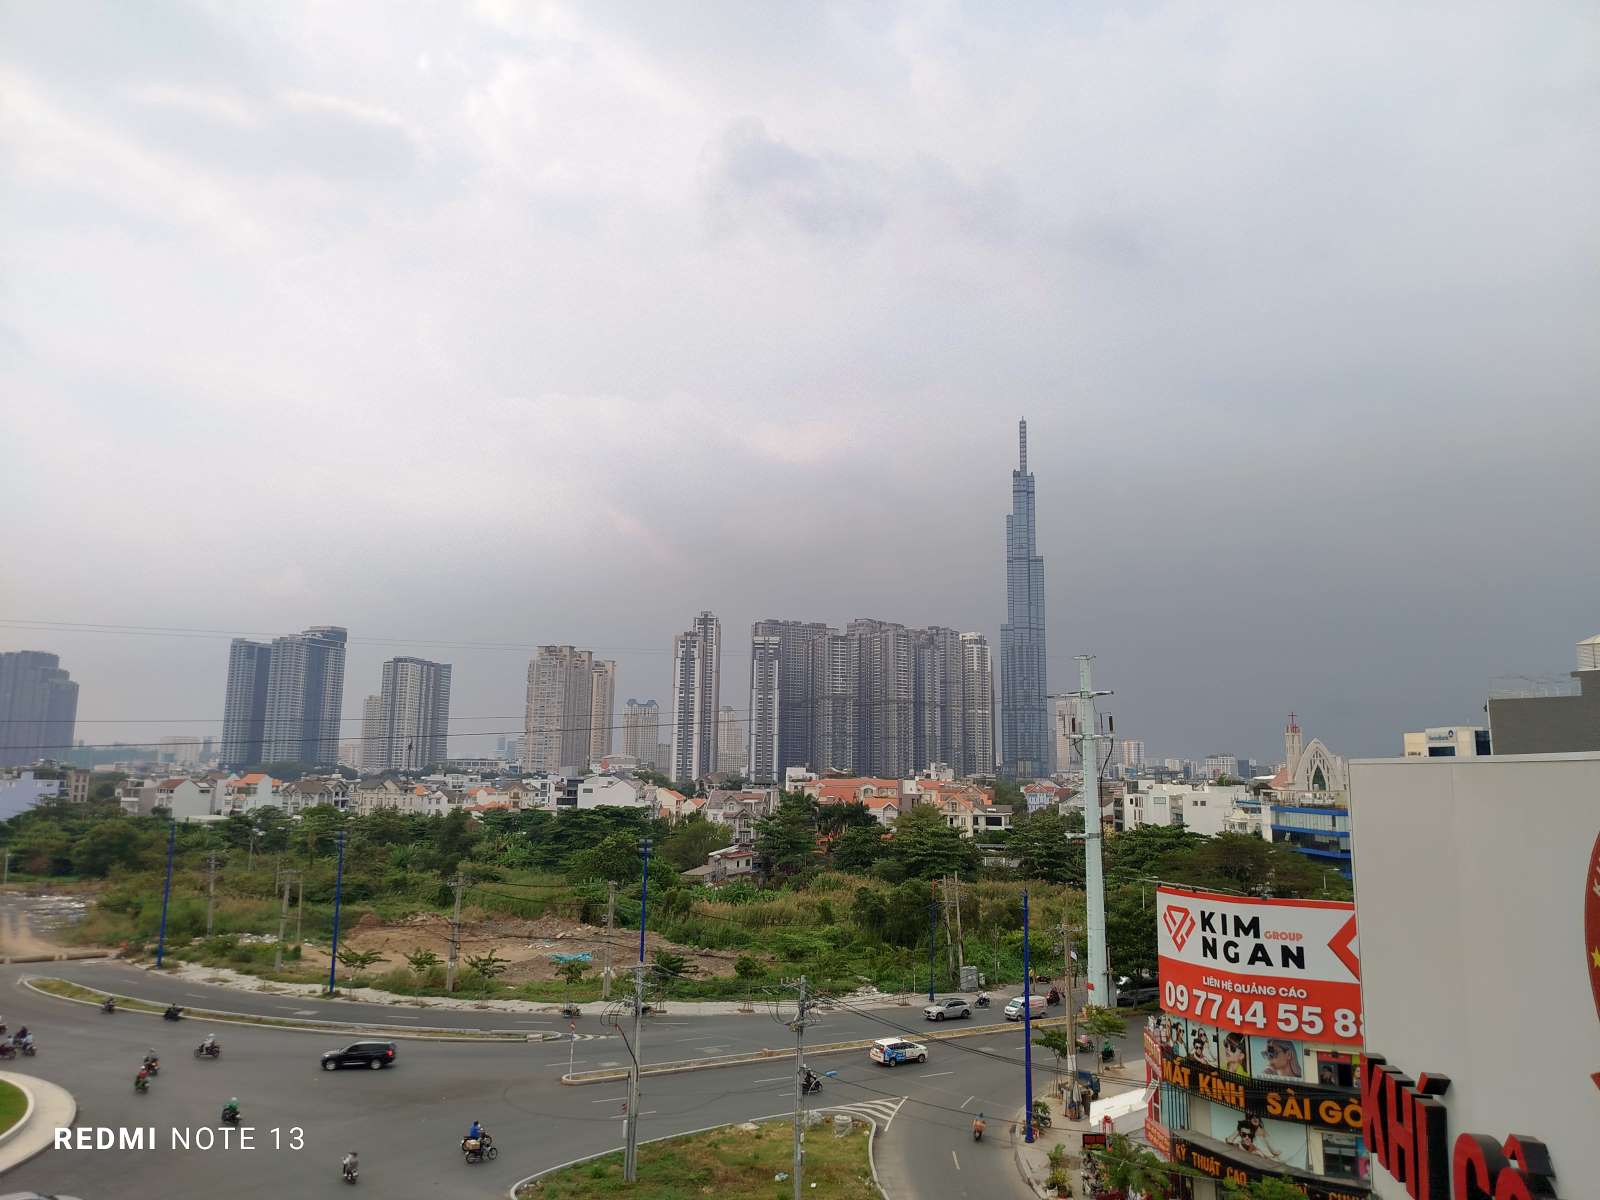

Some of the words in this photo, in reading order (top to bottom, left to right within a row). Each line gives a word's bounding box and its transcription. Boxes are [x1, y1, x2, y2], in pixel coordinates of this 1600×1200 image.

[1200, 910, 1261, 939] KIM
[1264, 930, 1303, 942] GROUP
[1202, 935, 1306, 970] NGAN
[1202, 975, 1221, 989] LIÊN
[1221, 979, 1233, 993] HỆ
[1234, 982, 1277, 996] QUẢNG
[1278, 985, 1307, 999] CÁO
[1333, 1008, 1364, 1038] 8
[1162, 1056, 1191, 1089] MẮT
[1199, 1071, 1245, 1108] KÍNH
[1266, 1087, 1311, 1121] SÀI
[1360, 1052, 1449, 1200] KHÍ
